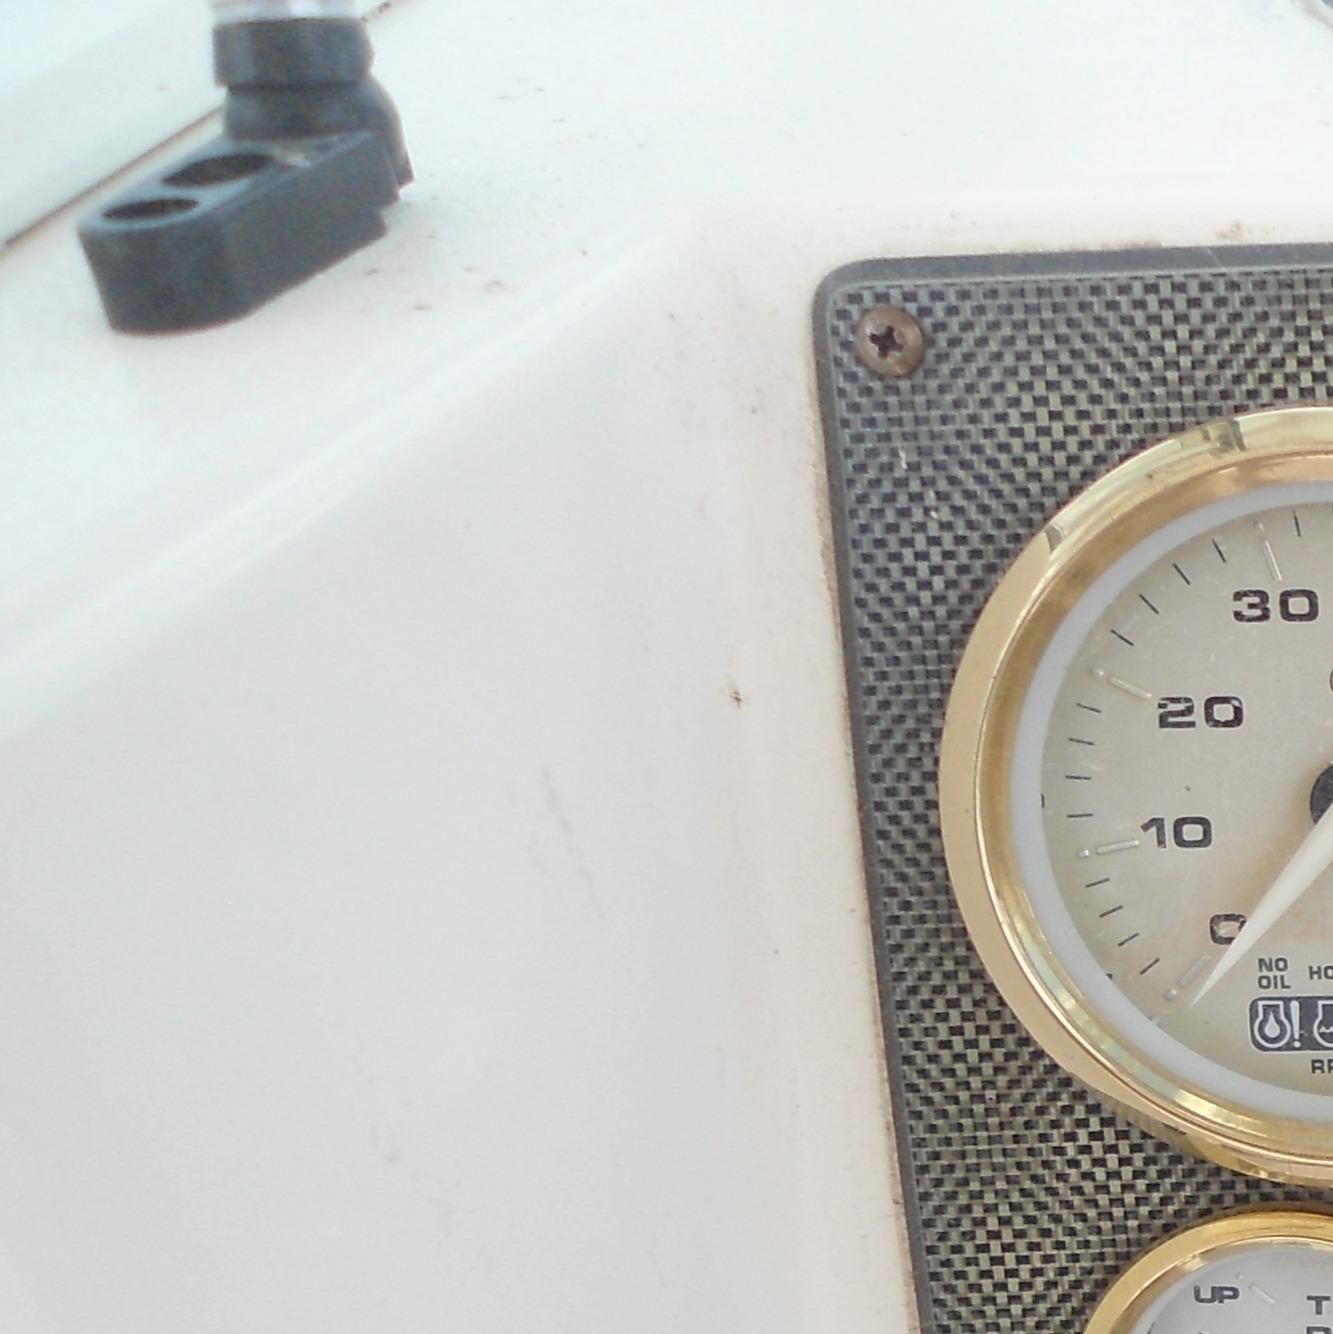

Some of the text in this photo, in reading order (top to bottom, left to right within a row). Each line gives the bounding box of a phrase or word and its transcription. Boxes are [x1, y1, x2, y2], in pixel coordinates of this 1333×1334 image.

[1232, 588, 1319, 623] 30
[1157, 695, 1244, 729] 20
[1140, 816, 1213, 850] 10
[1209, 913, 1248, 946] 0
[1258, 957, 1288, 972] NO
[1258, 975, 1291, 990] OIL
[1193, 1286, 1240, 1304] UP
